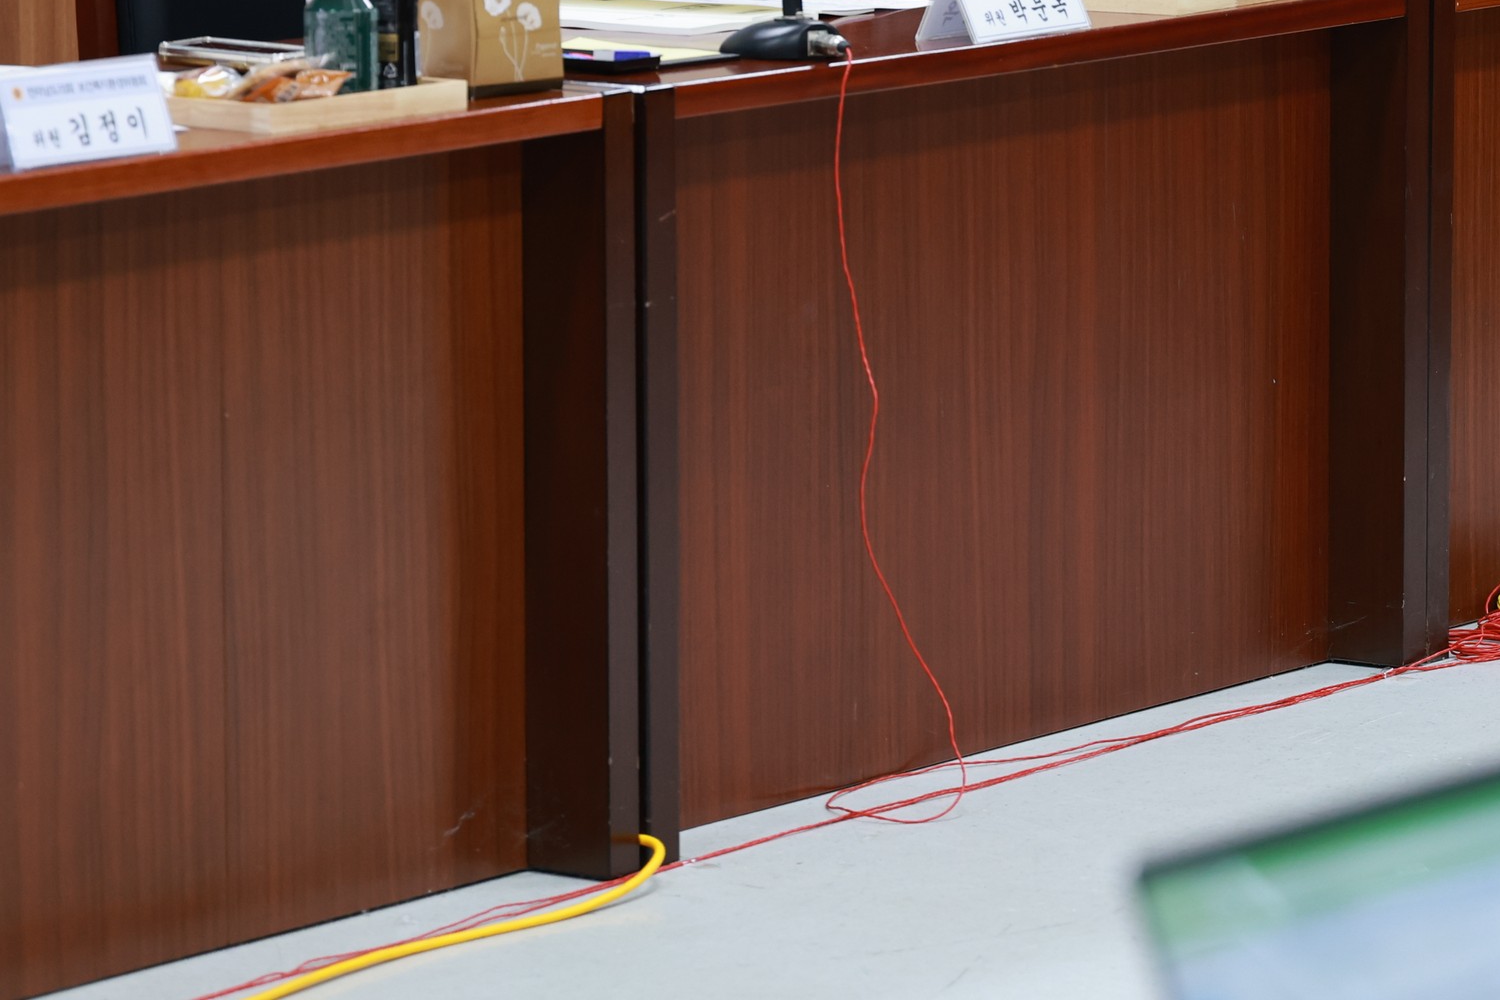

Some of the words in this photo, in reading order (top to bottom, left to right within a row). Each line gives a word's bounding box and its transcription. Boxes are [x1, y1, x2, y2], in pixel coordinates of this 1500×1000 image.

[985, 9, 1007, 26] 위원
[34, 127, 61, 147] 위원
[70, 106, 148, 146] 김정이
